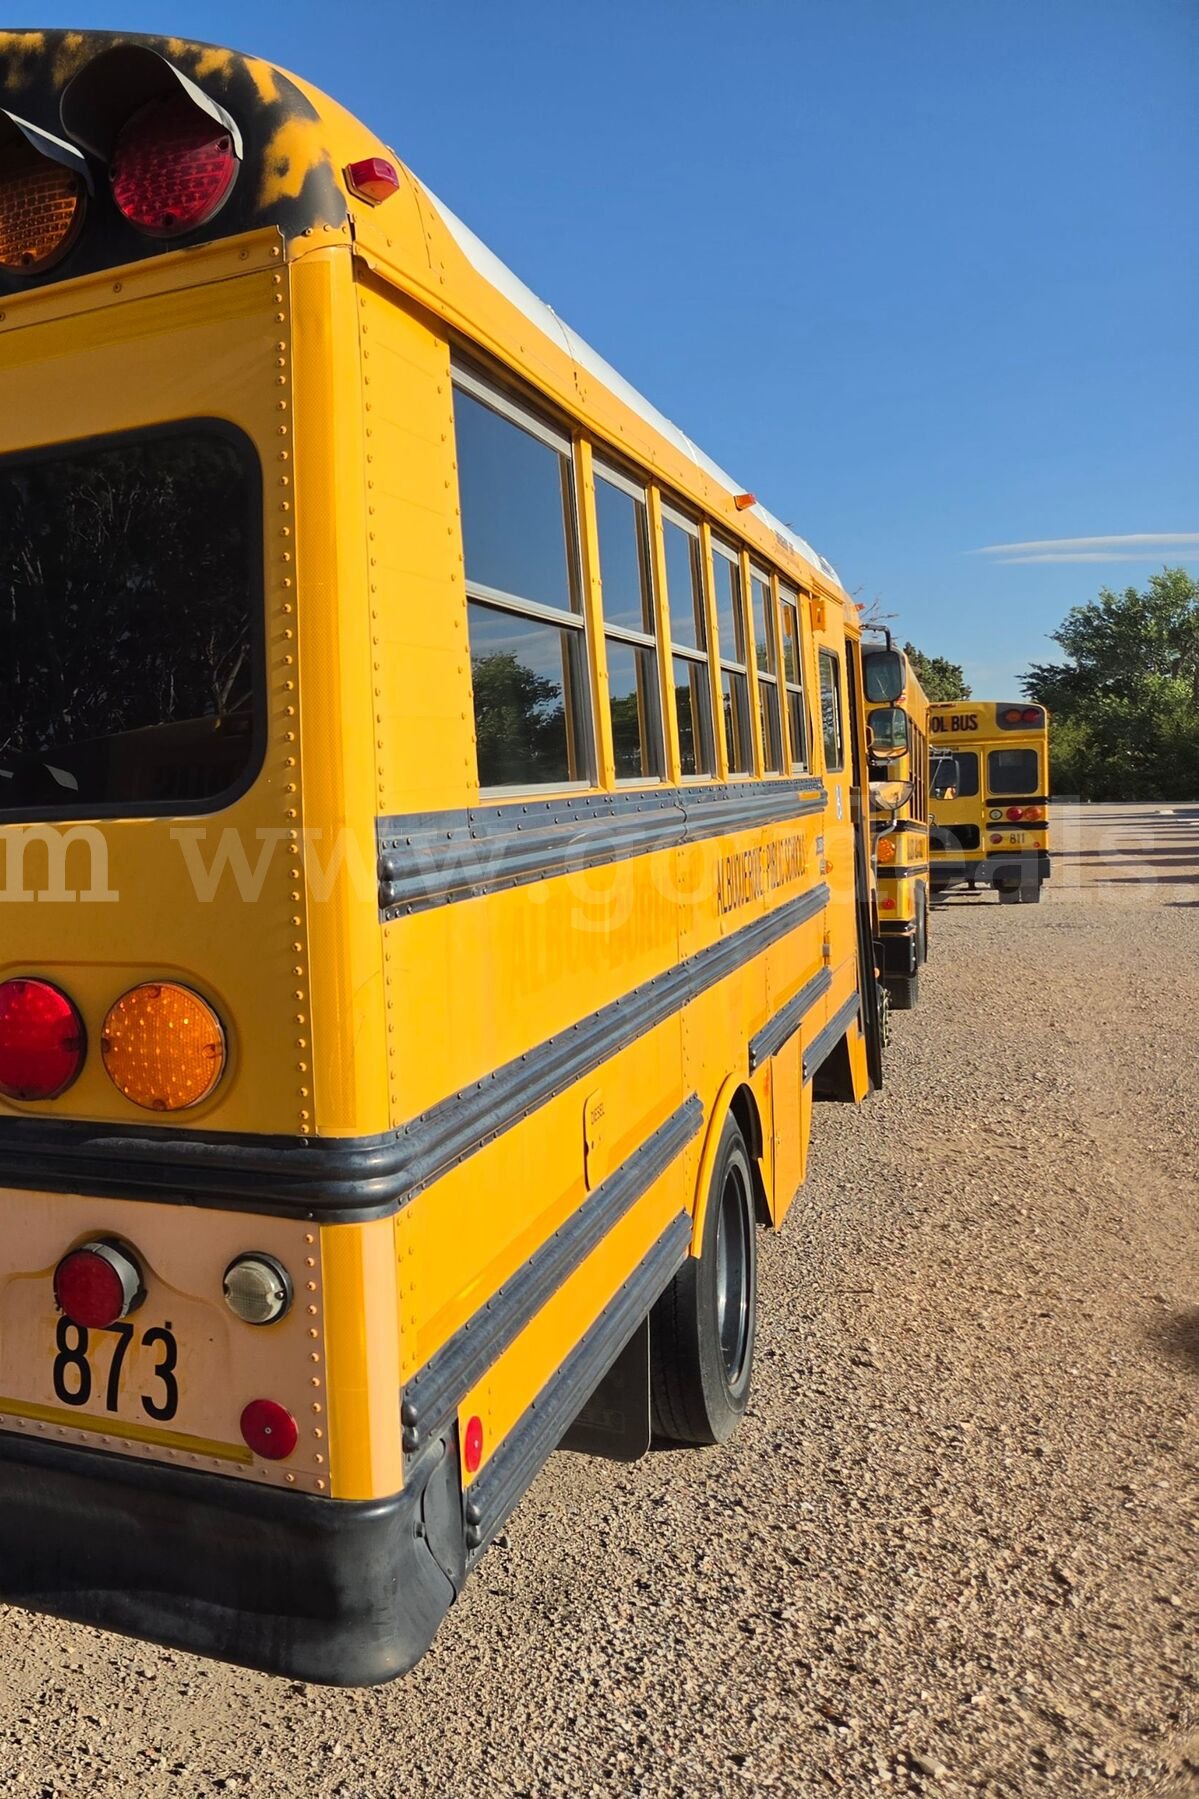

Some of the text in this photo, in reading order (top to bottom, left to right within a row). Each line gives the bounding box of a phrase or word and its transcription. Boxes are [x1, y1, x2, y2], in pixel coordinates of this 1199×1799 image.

[951, 714, 978, 731] BUS
[1009, 833, 1025, 844] 811
[53, 1315, 180, 1421] 873
